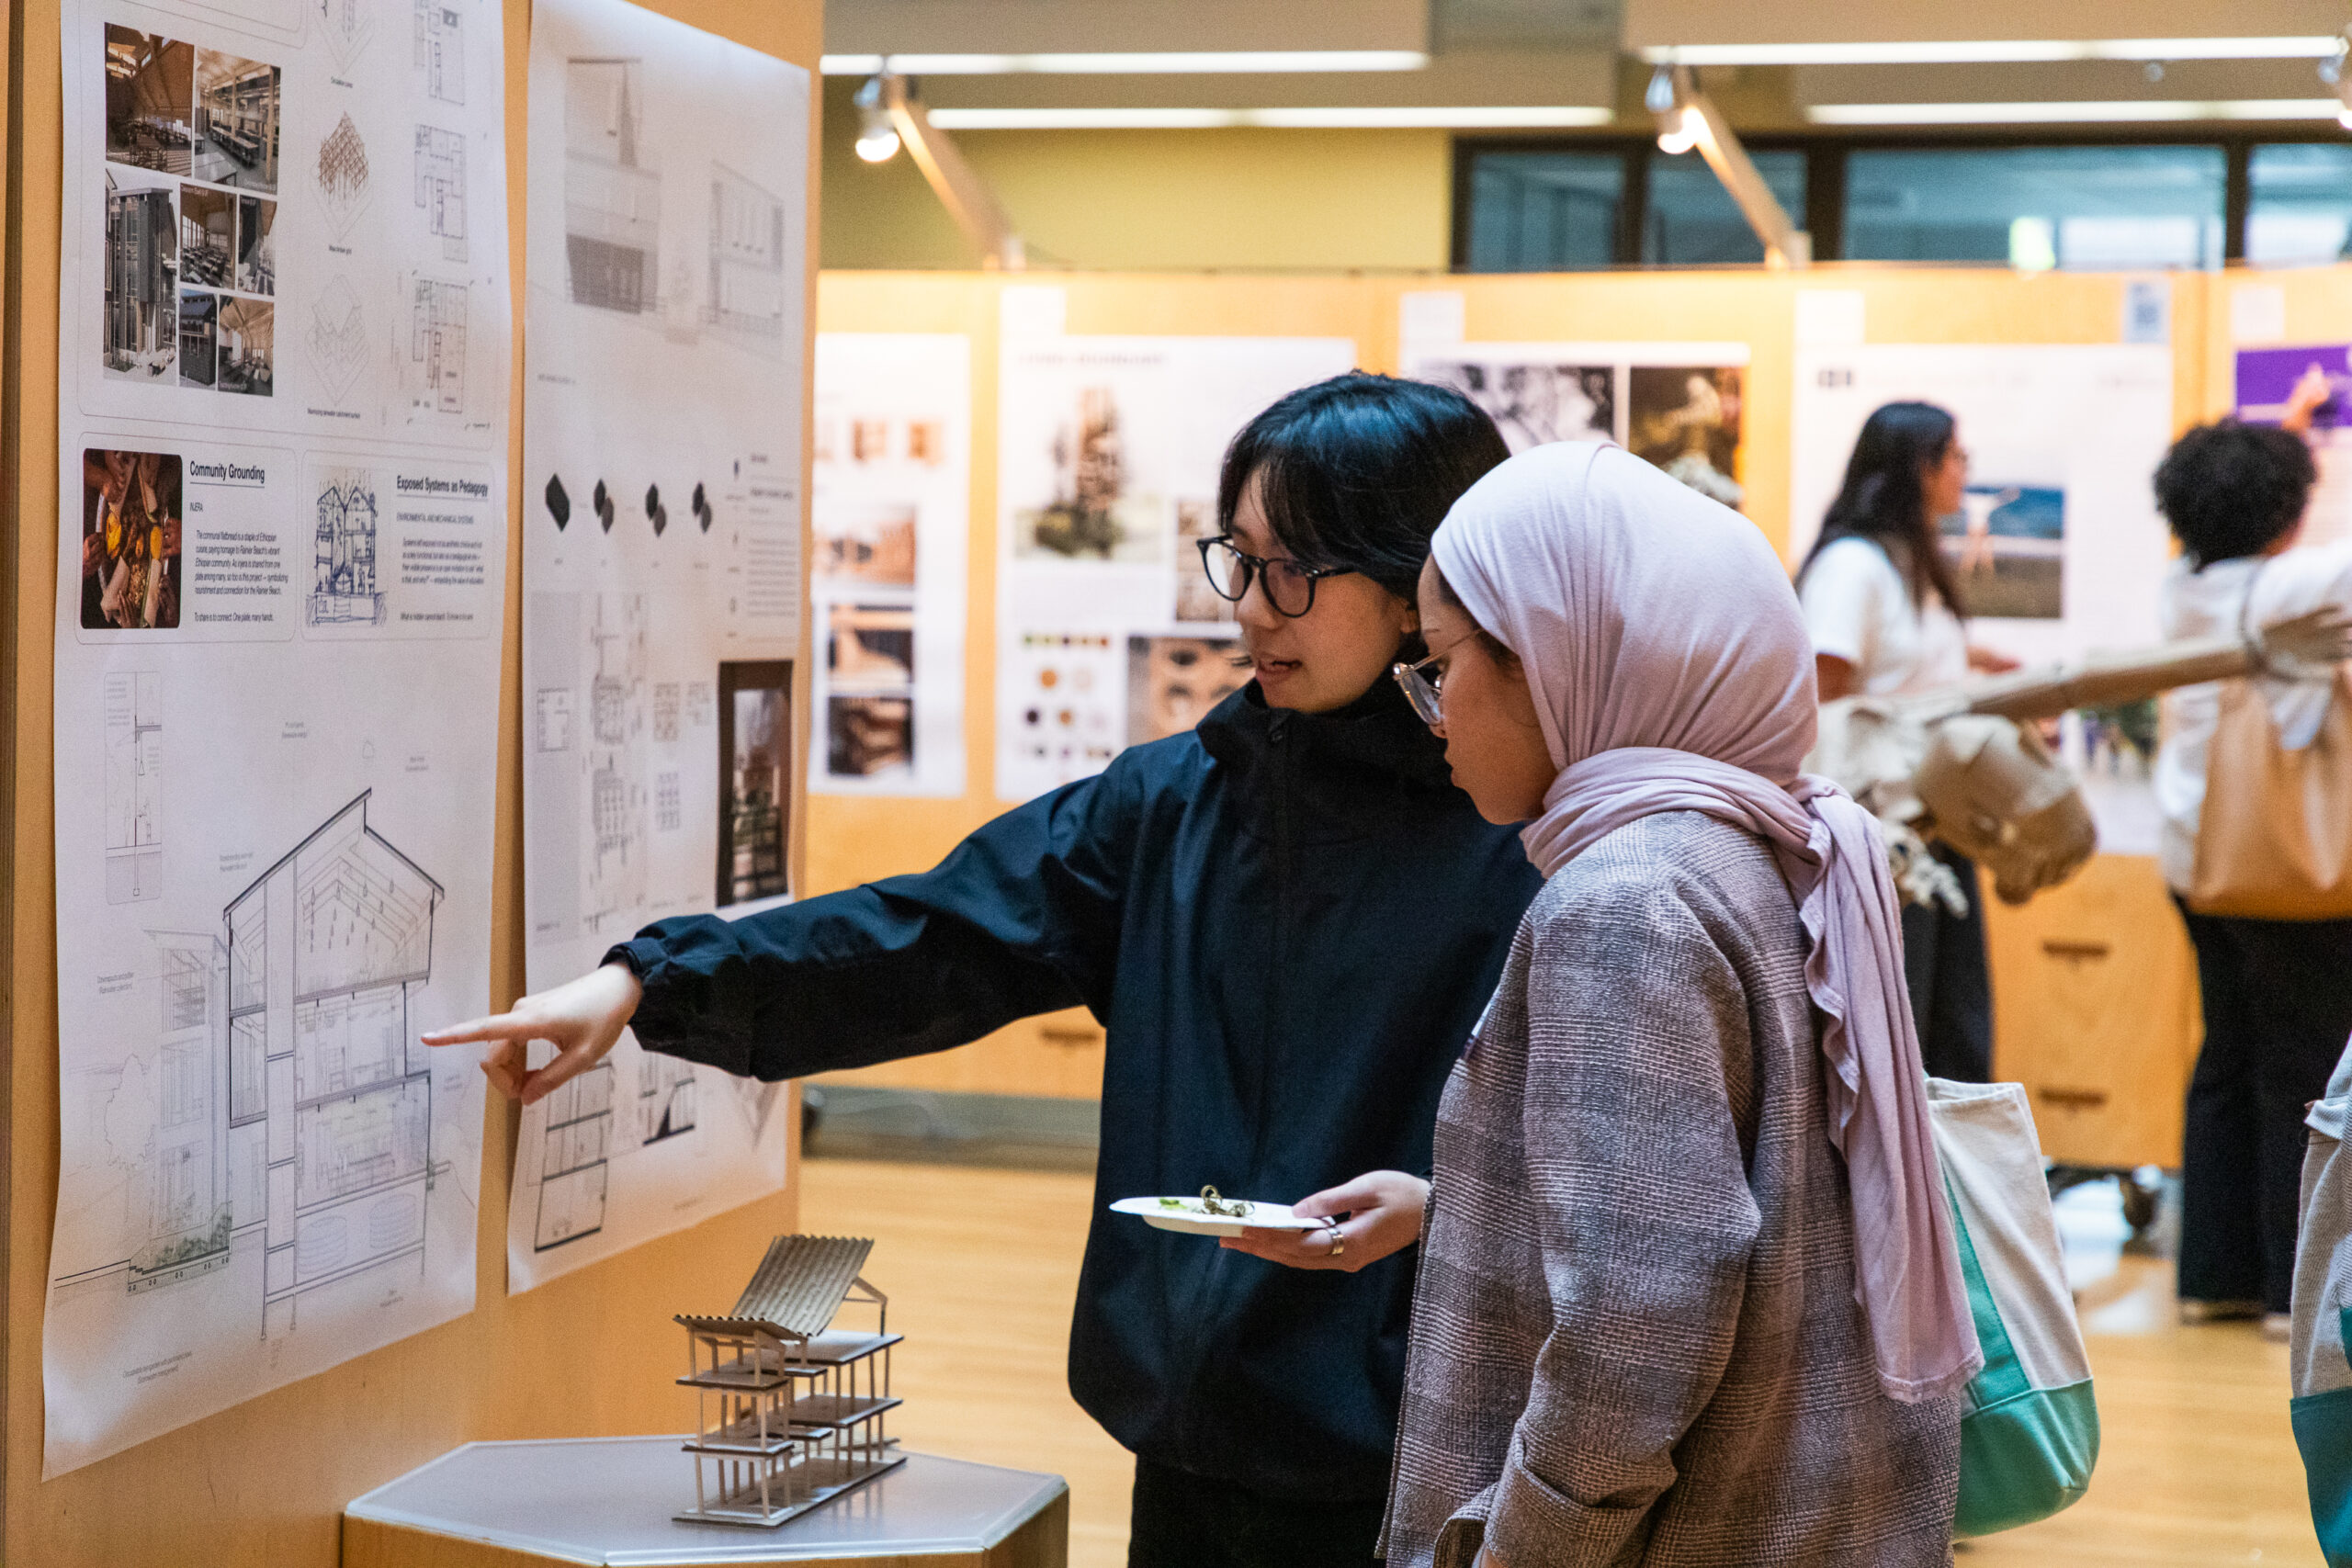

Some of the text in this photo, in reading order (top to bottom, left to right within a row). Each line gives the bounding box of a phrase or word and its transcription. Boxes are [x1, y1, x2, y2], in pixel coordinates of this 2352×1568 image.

[189, 460, 266, 484] Community Grounding
[397, 475, 489, 498] Exposed Systems as Pedagogy
